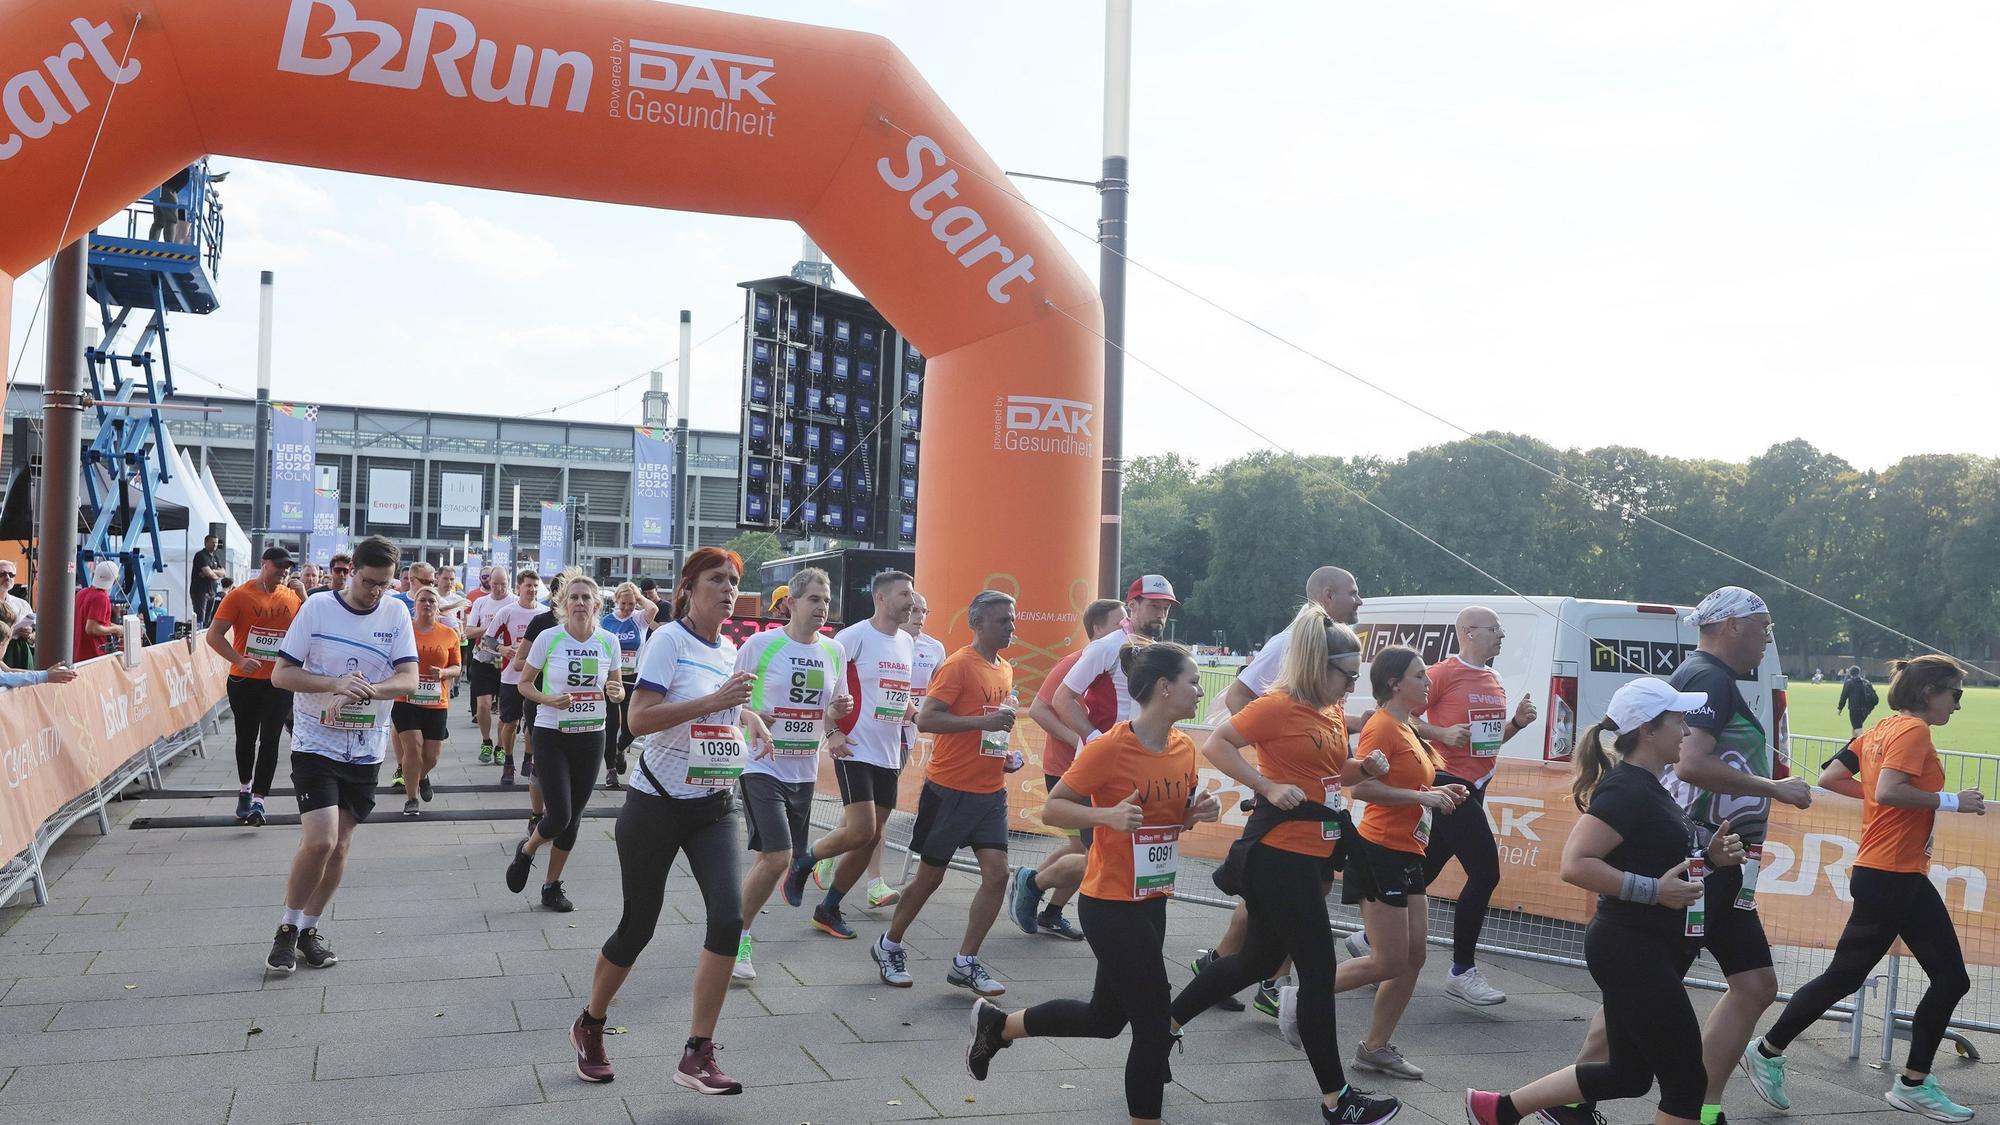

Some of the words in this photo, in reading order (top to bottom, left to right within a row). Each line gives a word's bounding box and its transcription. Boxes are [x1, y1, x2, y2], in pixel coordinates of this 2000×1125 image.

[609, 36, 625, 53] by
[277, 0, 593, 113] B2Run
[629, 38, 777, 106] DAK
[609, 56, 622, 118] powered
[626, 89, 777, 137] Gesundheit
[877, 135, 1036, 304] Start
[1006, 395, 1093, 437] DAK
[993, 404, 1002, 450] powered
[276, 443, 312, 453] UEFA
[1005, 430, 1093, 458] Gesundheit
[276, 453, 312, 462] EURO
[276, 462, 312, 471] 2024
[638, 463, 669, 472] UEFA
[638, 472, 669, 480] EURO
[638, 480, 669, 489] 2024
[373, 501, 405, 510] Energie
[443, 504, 479, 513] STADION
[255, 636, 279, 646] 6097
[565, 649, 598, 657] TEAM
[789, 657, 824, 668] TEAM
[792, 671, 806, 687] C
[789, 687, 818, 705] SZ
[568, 702, 596, 713] 8925
[784, 720, 814, 733] 8928
[1481, 721, 1501, 733] 7149
[700, 741, 740, 757] 10390
[1148, 844, 1173, 862] 6091
[1494, 837, 1540, 867] heit
